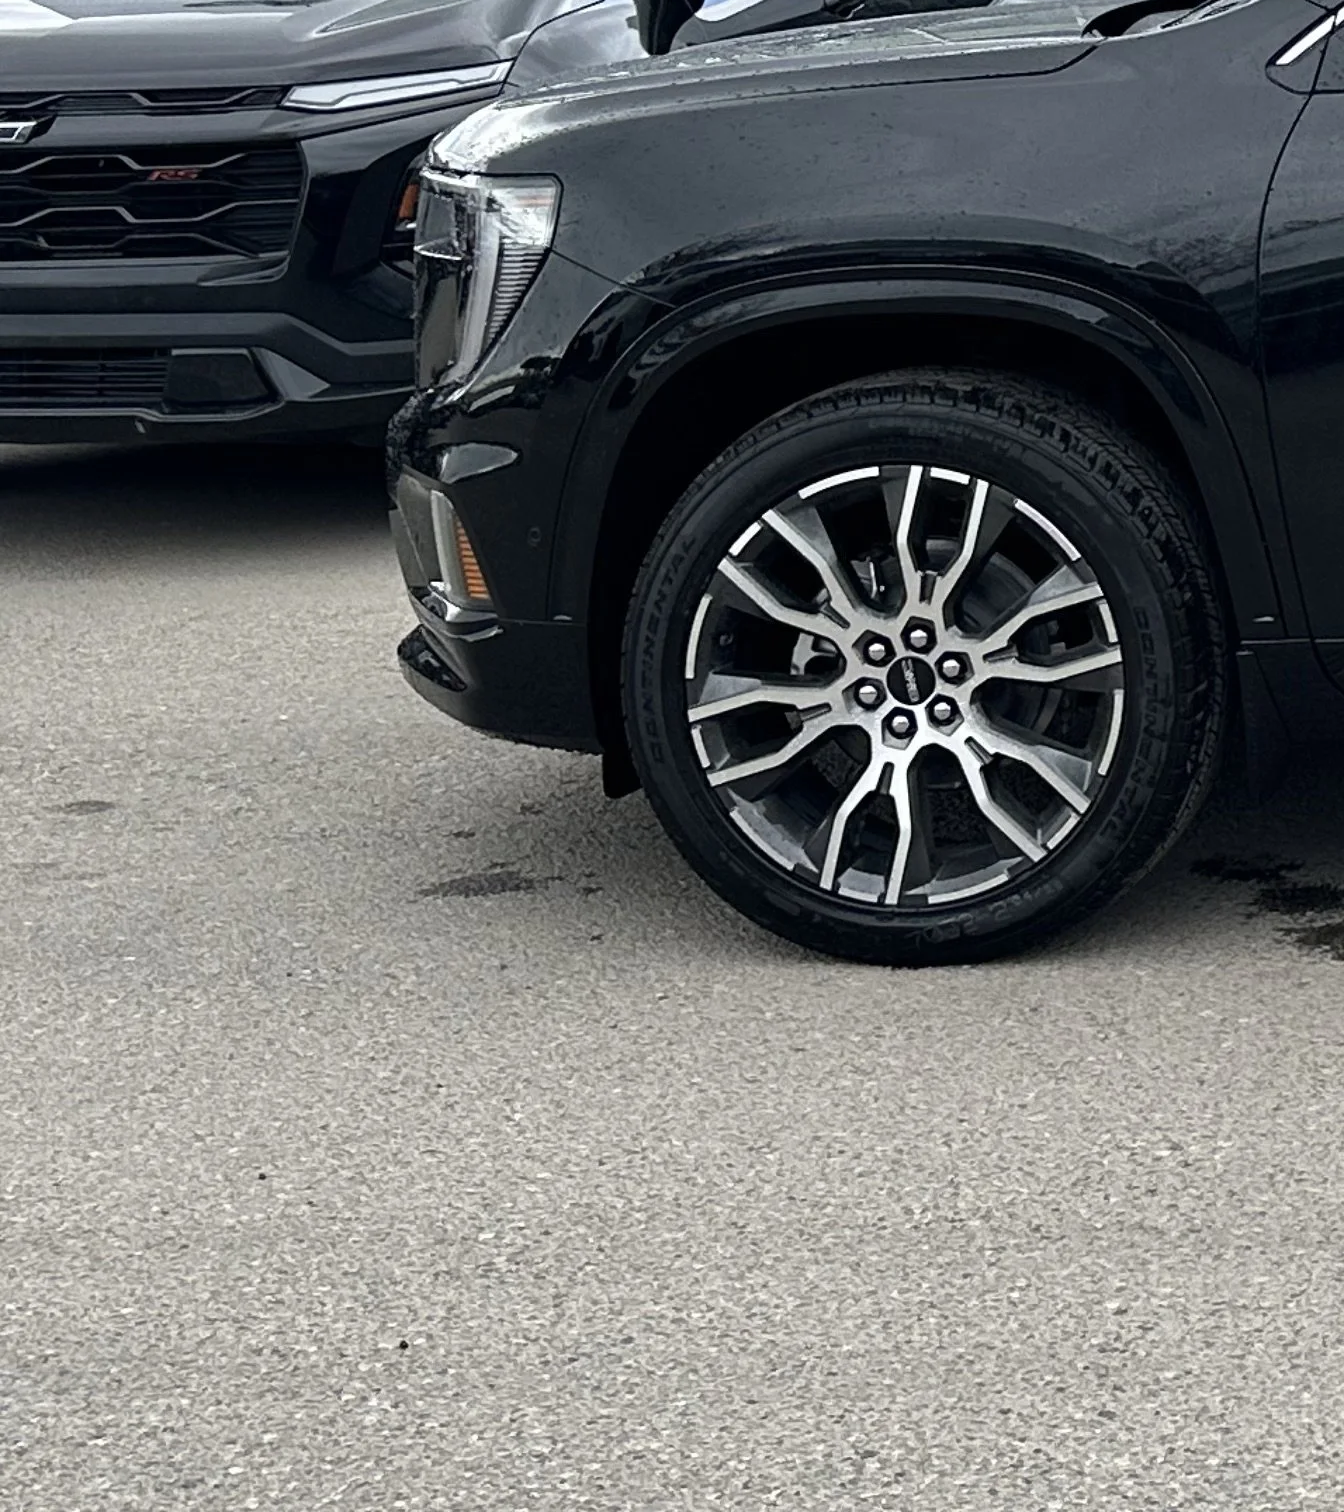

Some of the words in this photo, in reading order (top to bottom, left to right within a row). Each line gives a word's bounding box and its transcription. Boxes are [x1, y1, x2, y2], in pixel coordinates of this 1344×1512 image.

[148, 169, 202, 181] RS
[641, 535, 696, 765] CONTINENTAL
[1100, 606, 1157, 841] CONTINENTAL
